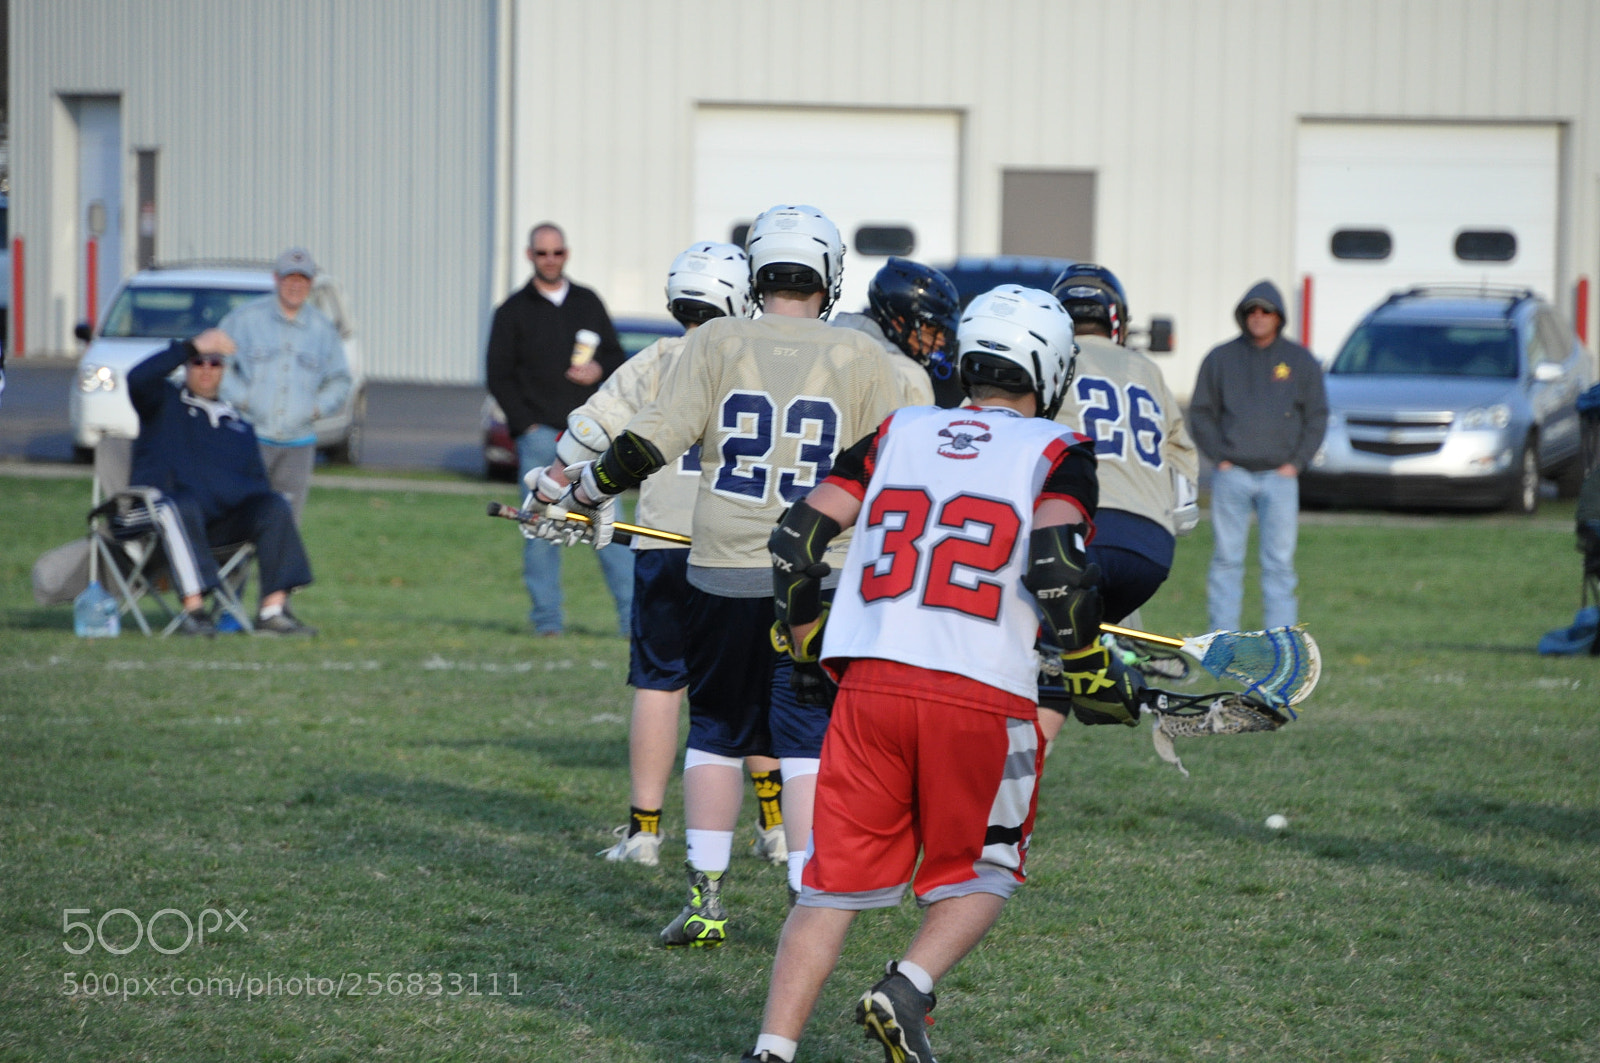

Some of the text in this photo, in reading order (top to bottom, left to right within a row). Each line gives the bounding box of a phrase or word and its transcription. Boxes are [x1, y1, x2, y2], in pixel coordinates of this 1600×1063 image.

[711, 388, 843, 508] 23
[1072, 374, 1165, 472] 26
[857, 484, 1025, 626] 32
[1037, 585, 1068, 599] STX
